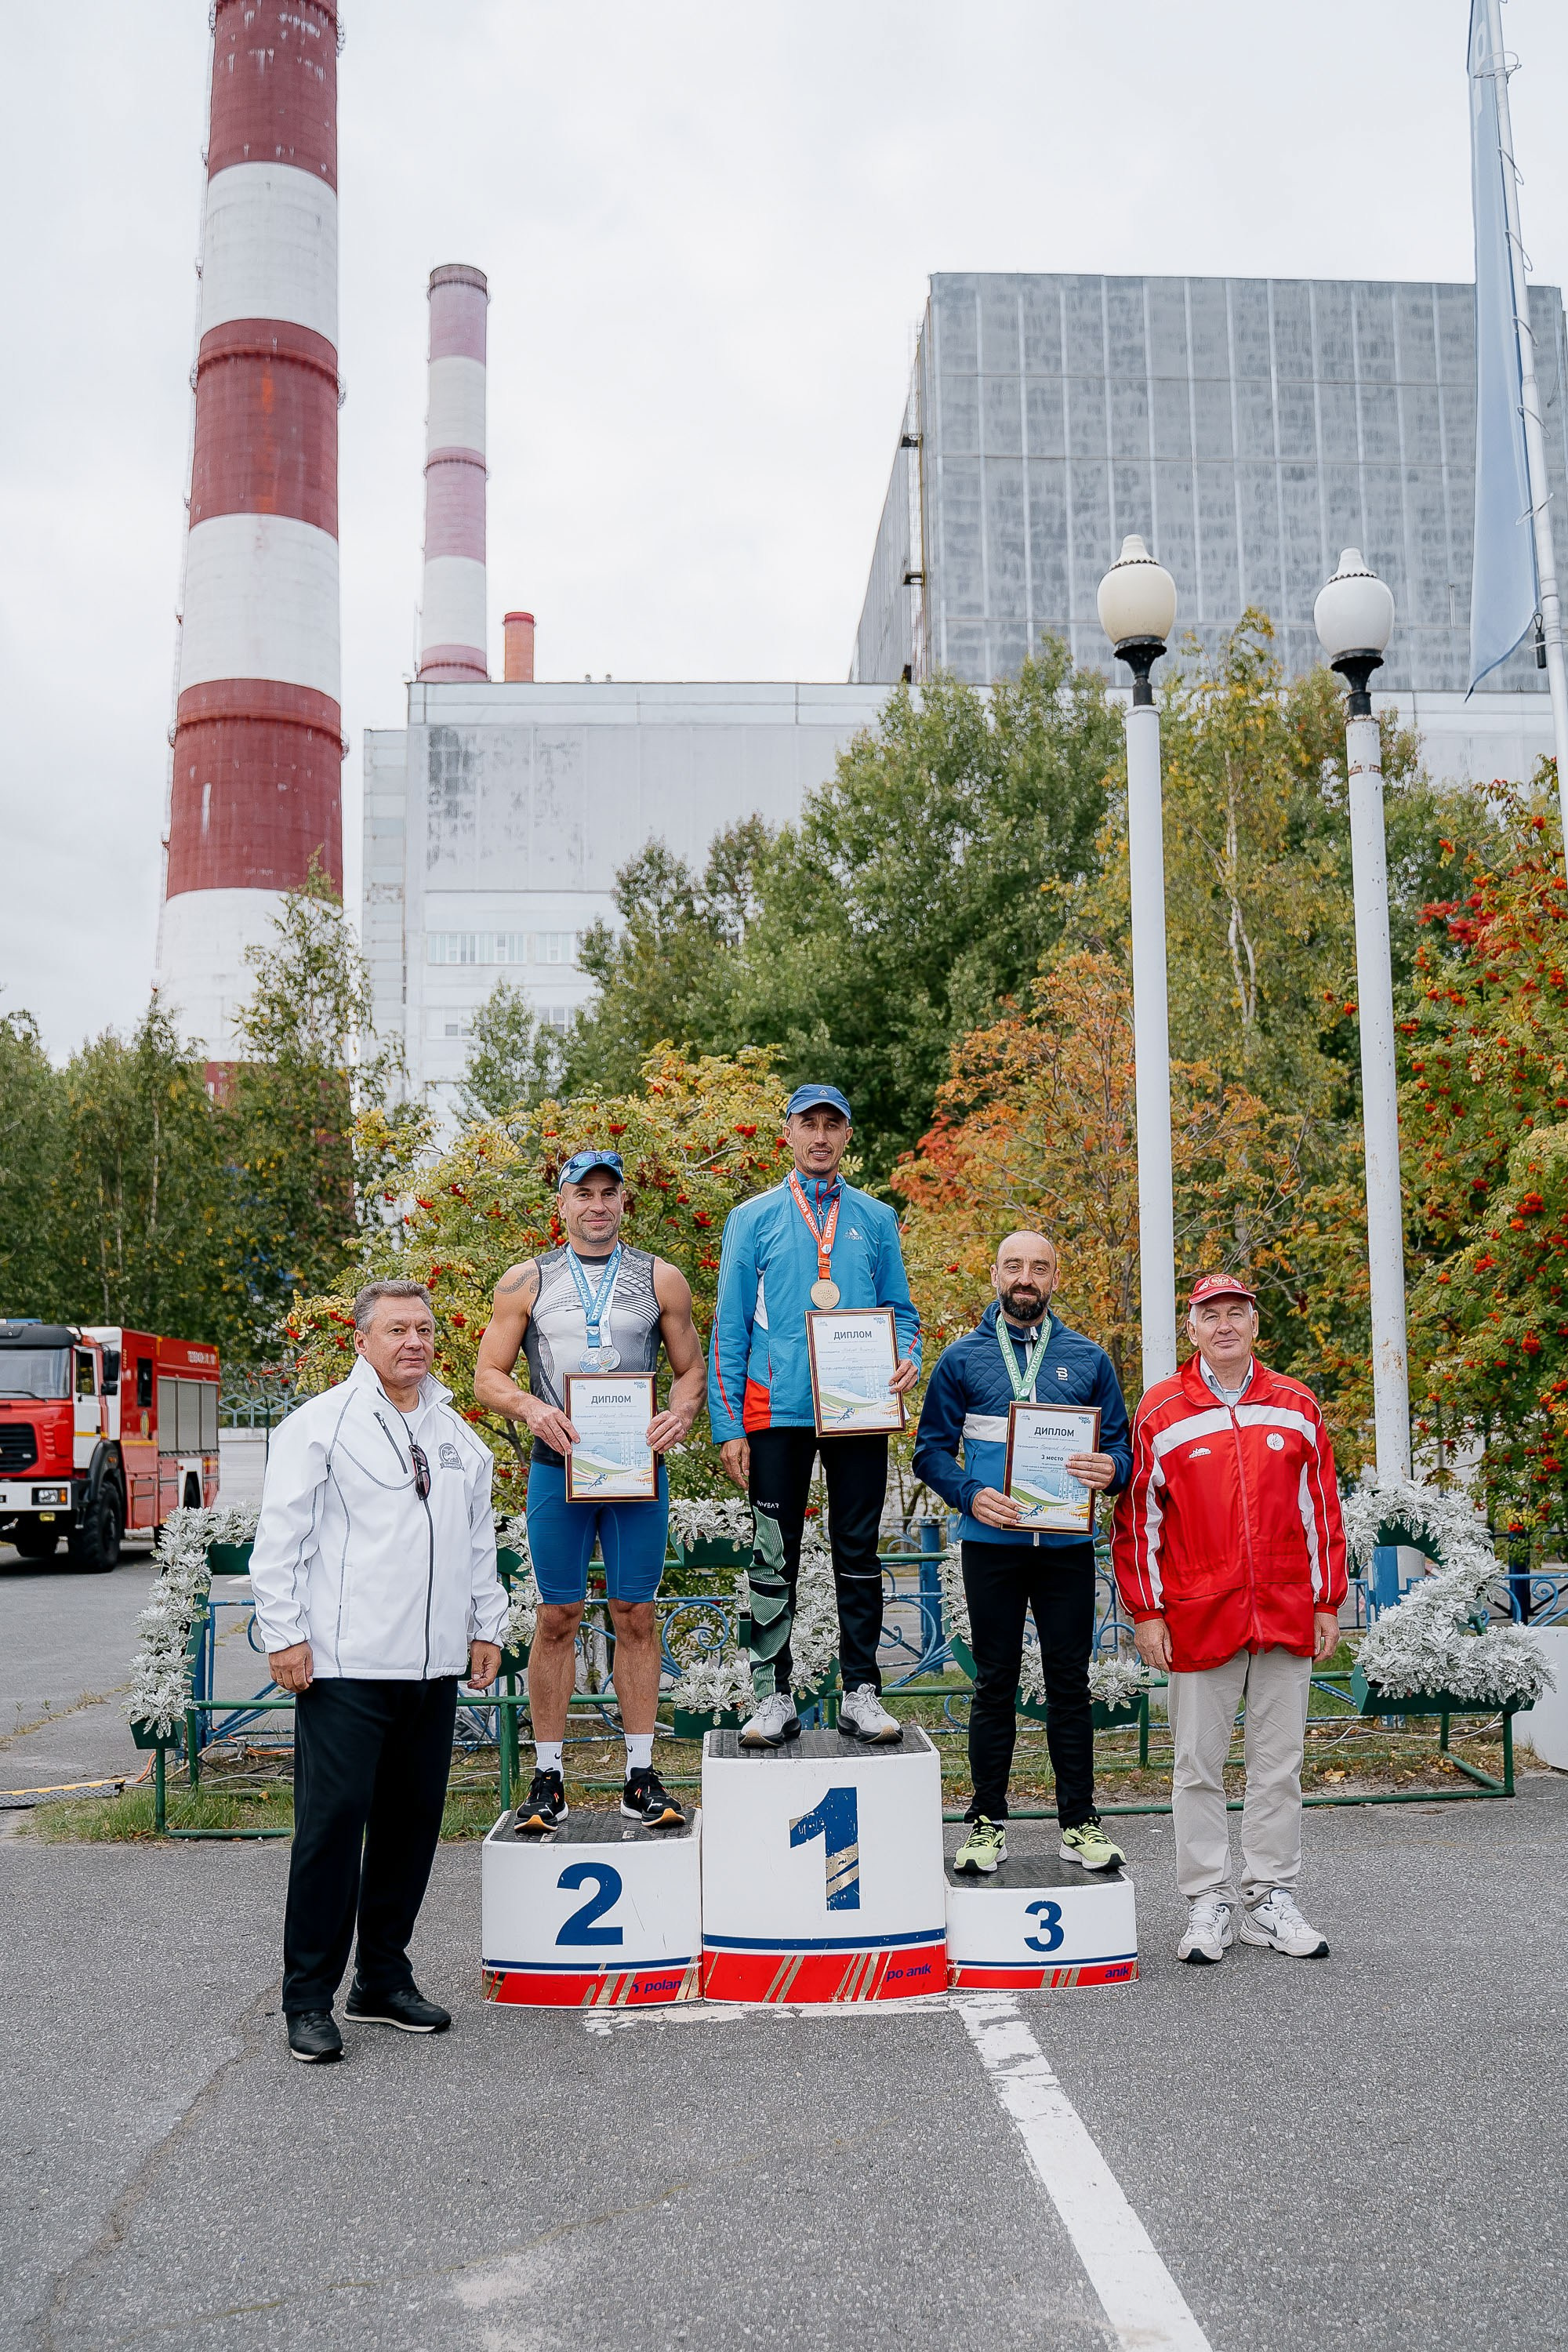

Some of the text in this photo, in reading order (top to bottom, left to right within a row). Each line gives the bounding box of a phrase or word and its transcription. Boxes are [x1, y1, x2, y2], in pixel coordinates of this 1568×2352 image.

[794, 1187, 808, 1213] КОЛЬЦО
[574, 1269, 591, 1308] СУРГУТСКОЕ
[591, 1281, 609, 1320] СУРГУТСКОЕ
[605, 1257, 618, 1280] КОЛЬЦО
[834, 1331, 872, 1340] ДИПЛОМ
[999, 1328, 1010, 1353] КОЛЬЦО
[1025, 1344, 1043, 1382] СУРГУТСКОЕ
[591, 1396, 631, 1404] ДИПЛОМ
[1034, 1427, 1074, 1436] ДИПЛОМ
[789, 1787, 861, 1911] 1
[555, 1862, 623, 1945] 2
[1024, 1900, 1065, 1952] 3
